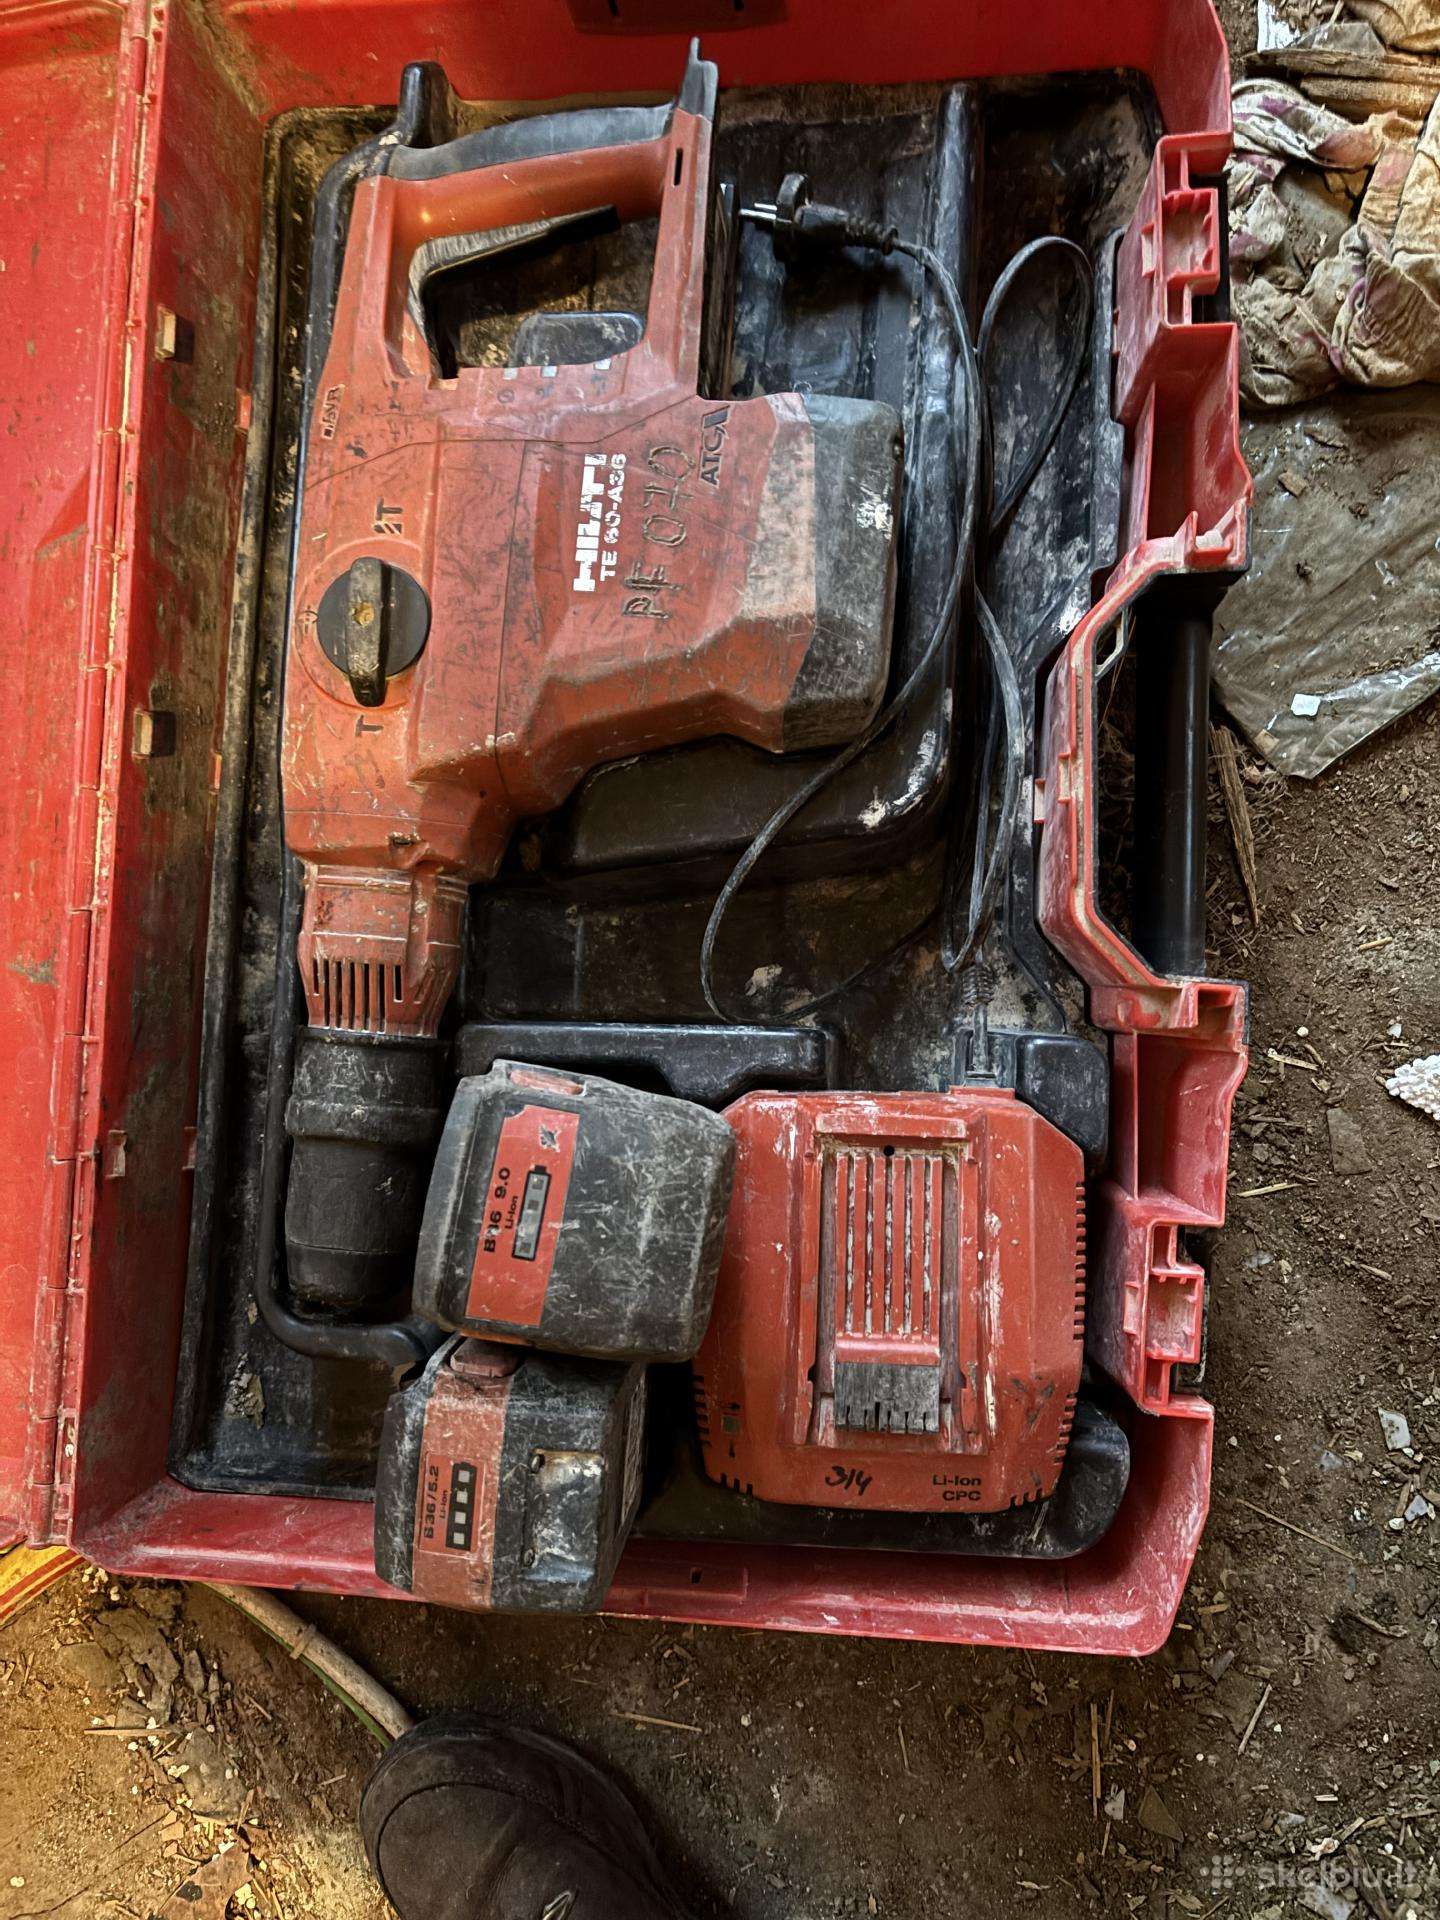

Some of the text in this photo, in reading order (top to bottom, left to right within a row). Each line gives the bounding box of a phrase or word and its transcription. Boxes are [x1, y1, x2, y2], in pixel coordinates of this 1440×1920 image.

[573, 454, 607, 591] HILTI
[600, 454, 626, 581] TE 60-A36
[494, 1167, 511, 1199] 9.0
[504, 1195, 518, 1229] Li-Ion
[932, 1474, 981, 1486] Li-Ion
[942, 1491, 981, 1501] CPC
